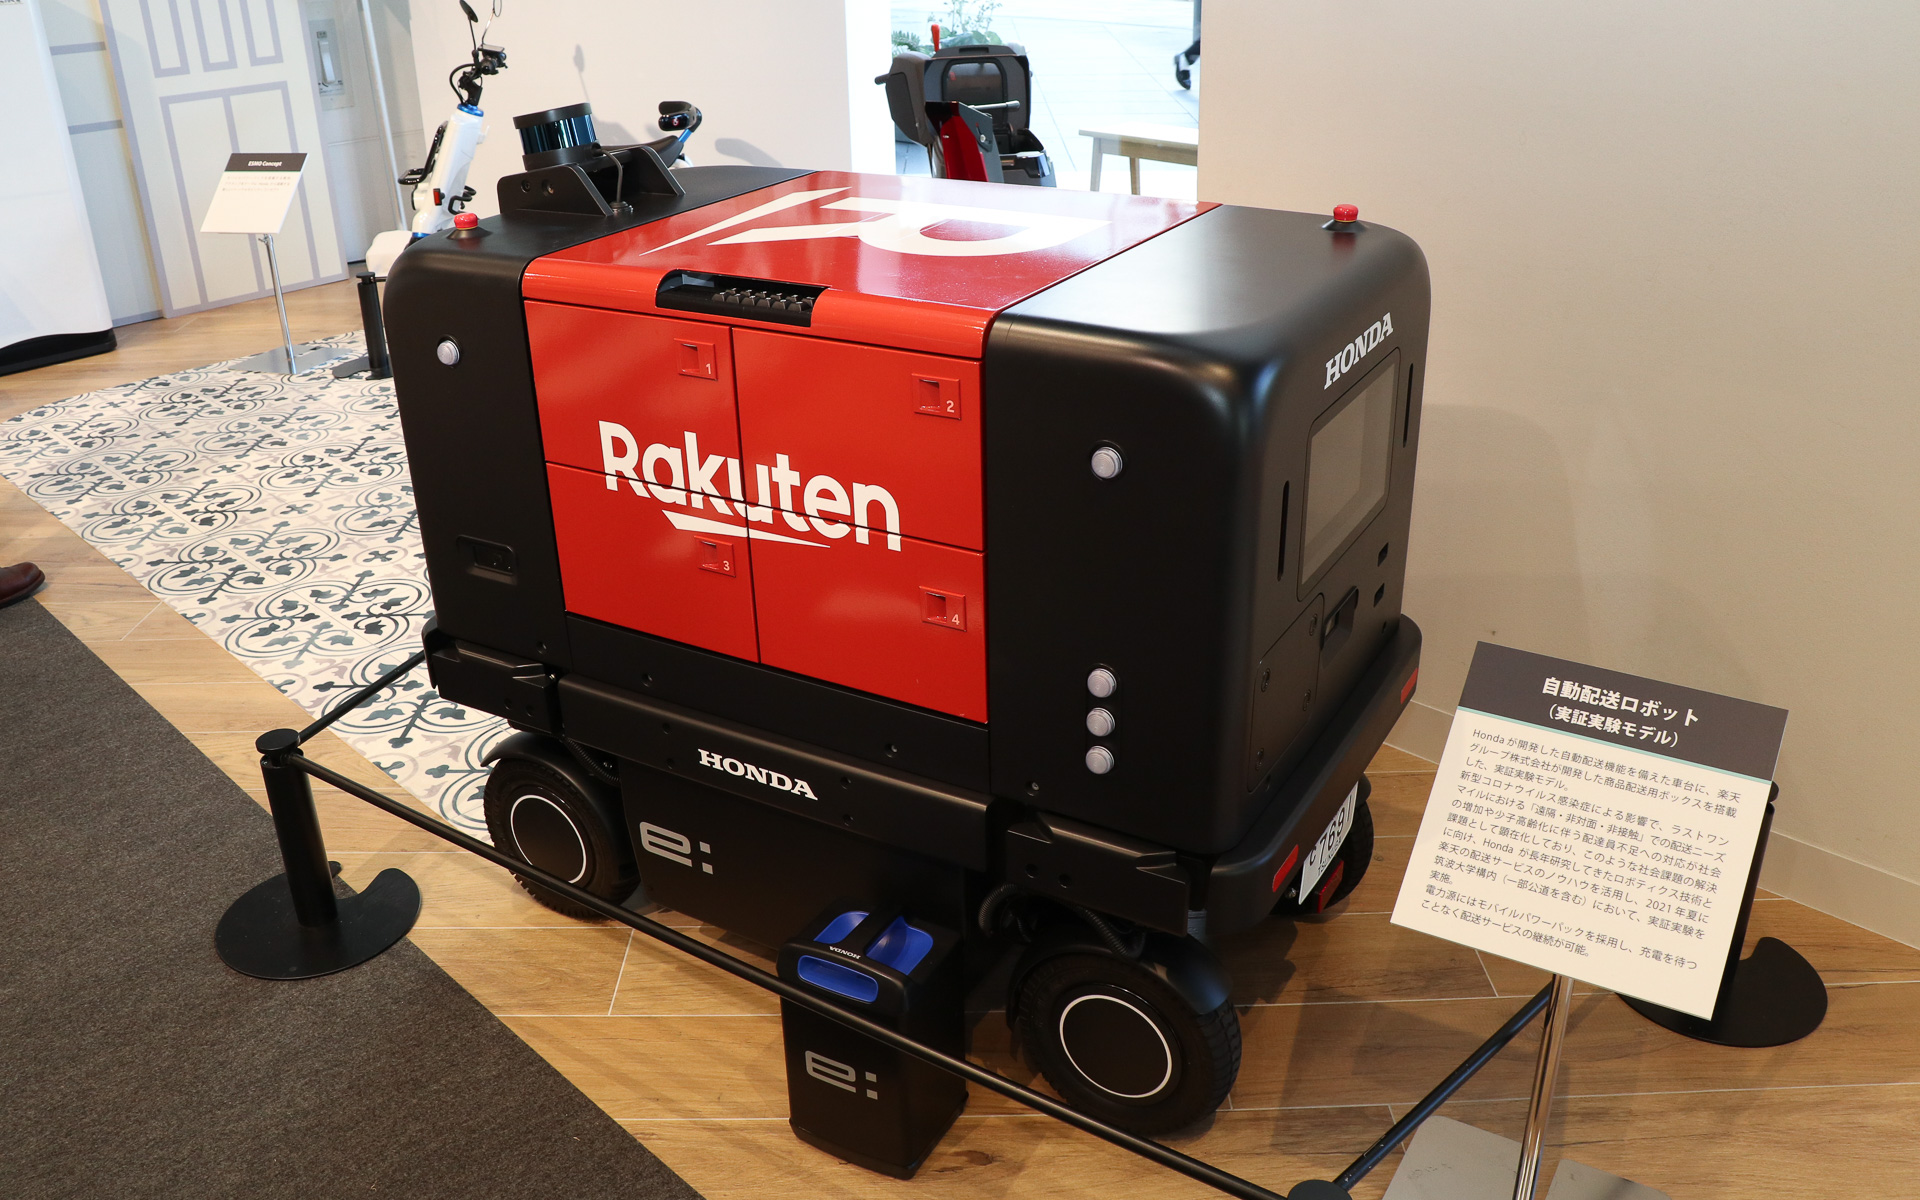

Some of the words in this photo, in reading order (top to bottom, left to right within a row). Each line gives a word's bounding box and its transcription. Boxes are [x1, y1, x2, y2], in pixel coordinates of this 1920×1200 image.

[1324, 312, 1394, 390] HONDA
[705, 363, 712, 375] 1
[946, 400, 955, 413] 2
[599, 420, 902, 552] Rakuten
[723, 560, 730, 571] 3
[951, 613, 960, 626] 4
[1542, 677, 1699, 727] 自動配送ロボット
[698, 748, 818, 800] HONDA
[829, 945, 861, 960] HONDA
